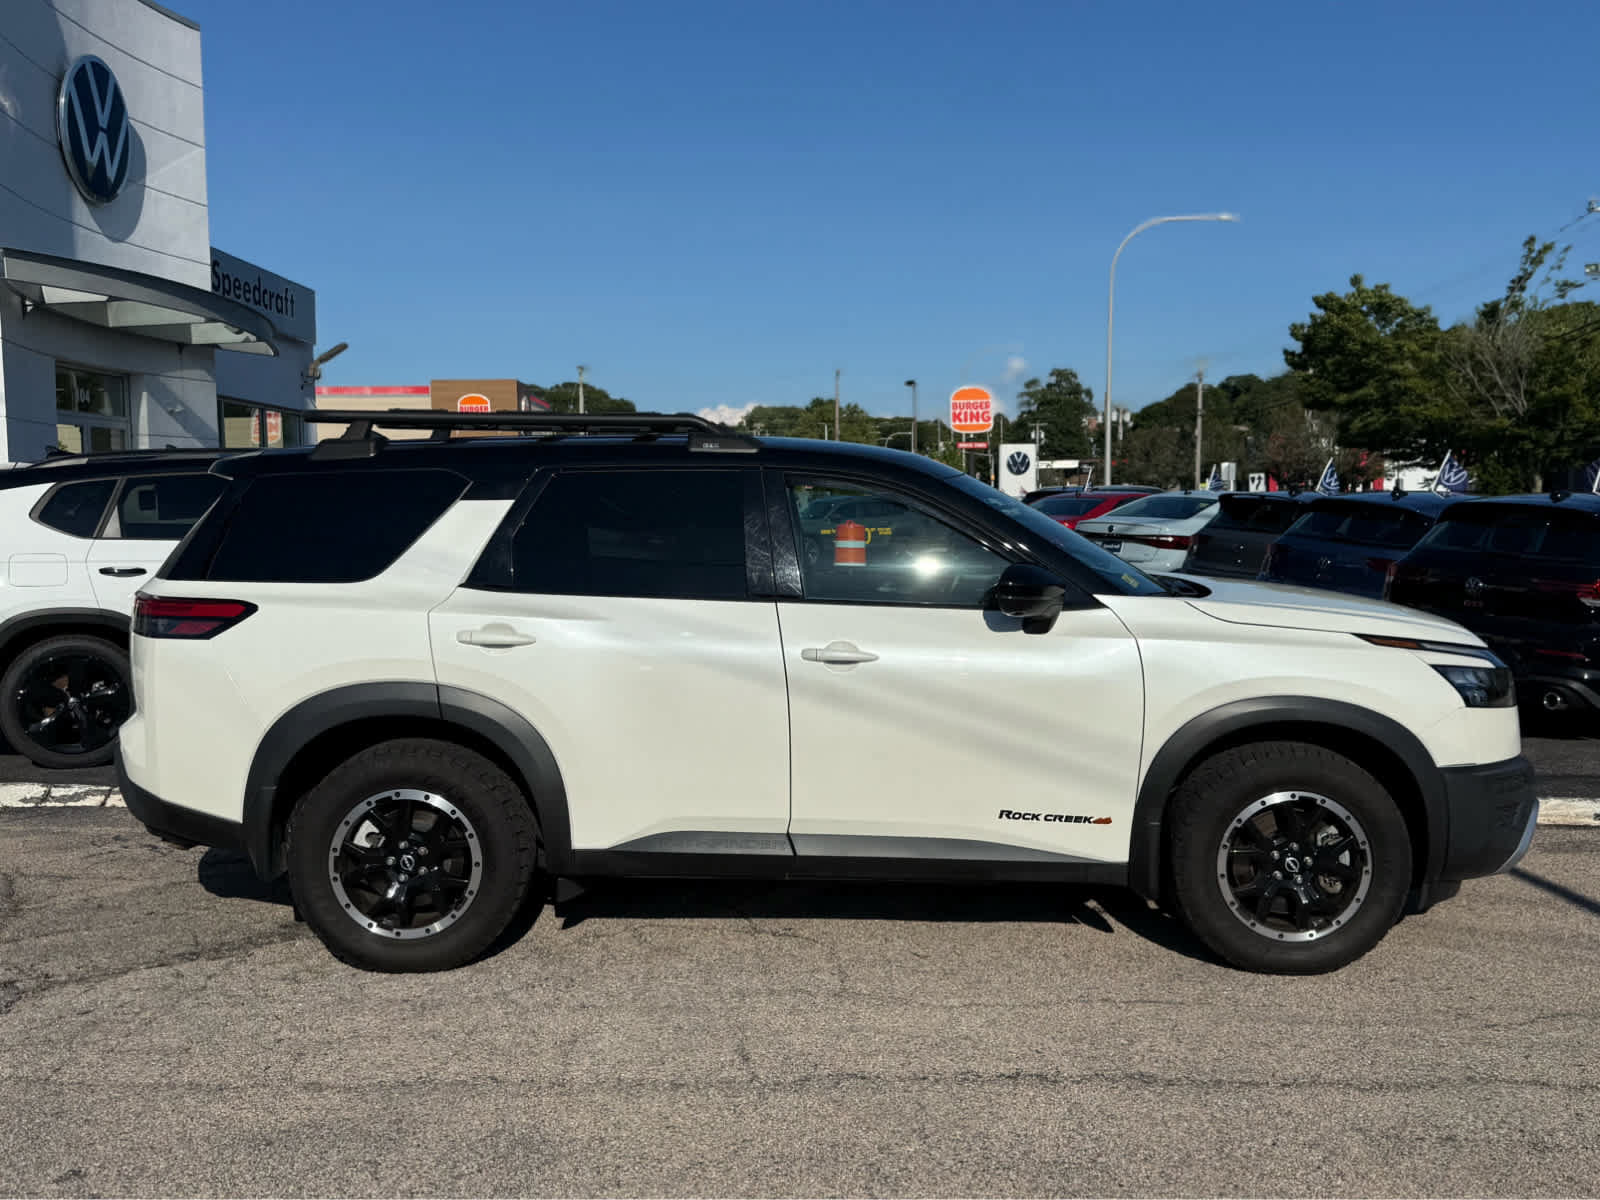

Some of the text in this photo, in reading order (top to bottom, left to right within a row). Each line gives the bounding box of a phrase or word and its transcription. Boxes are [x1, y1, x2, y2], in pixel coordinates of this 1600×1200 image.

[212, 260, 295, 318] Speedcraft
[951, 401, 991, 410] BURGER
[951, 410, 992, 423] KING
[1043, 814, 1094, 824] CREEK
